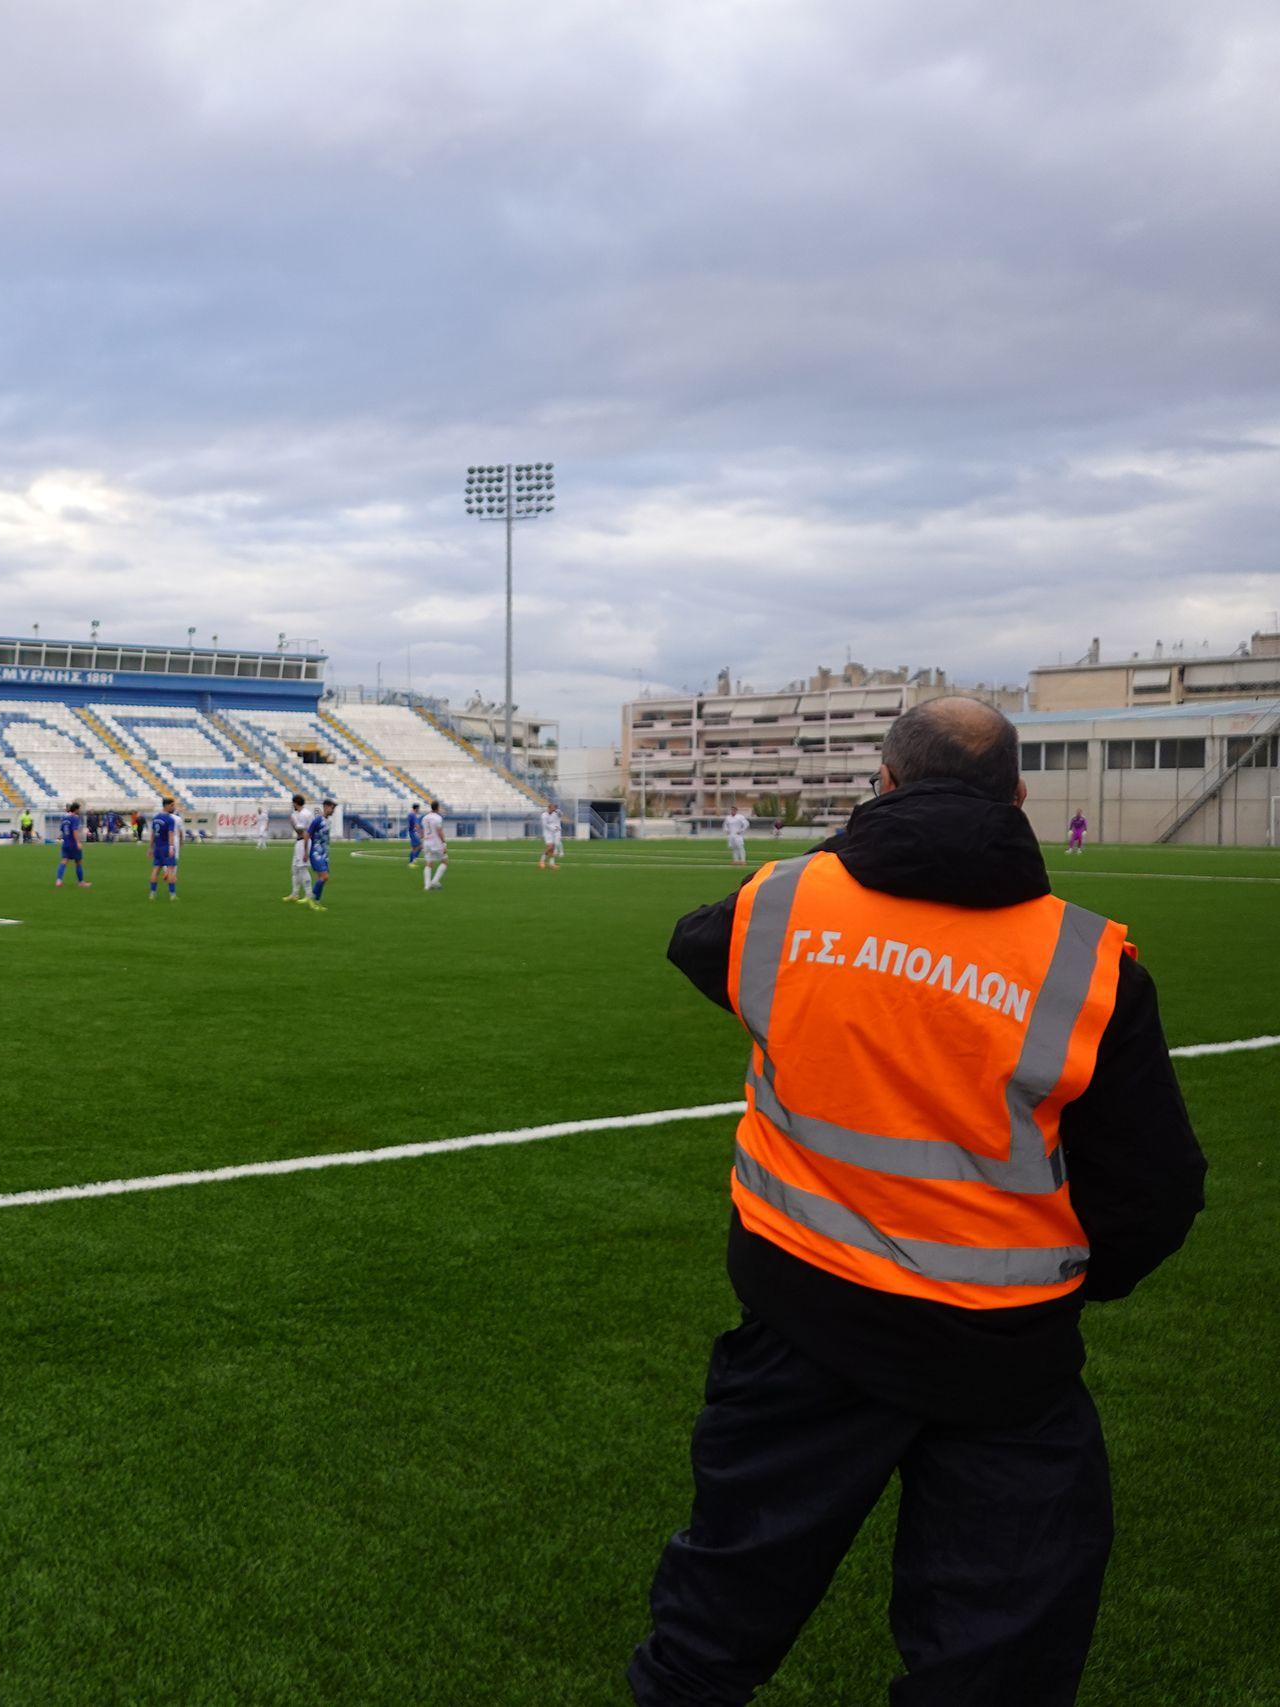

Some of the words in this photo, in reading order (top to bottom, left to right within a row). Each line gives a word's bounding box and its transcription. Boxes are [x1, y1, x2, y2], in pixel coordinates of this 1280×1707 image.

[86, 671, 114, 685] 1891
[218, 813, 258, 826] everes
[788, 930, 846, 965] Γ.Σ.
[852, 936, 1031, 1023] ΑΠΟΛΛΩΝ
